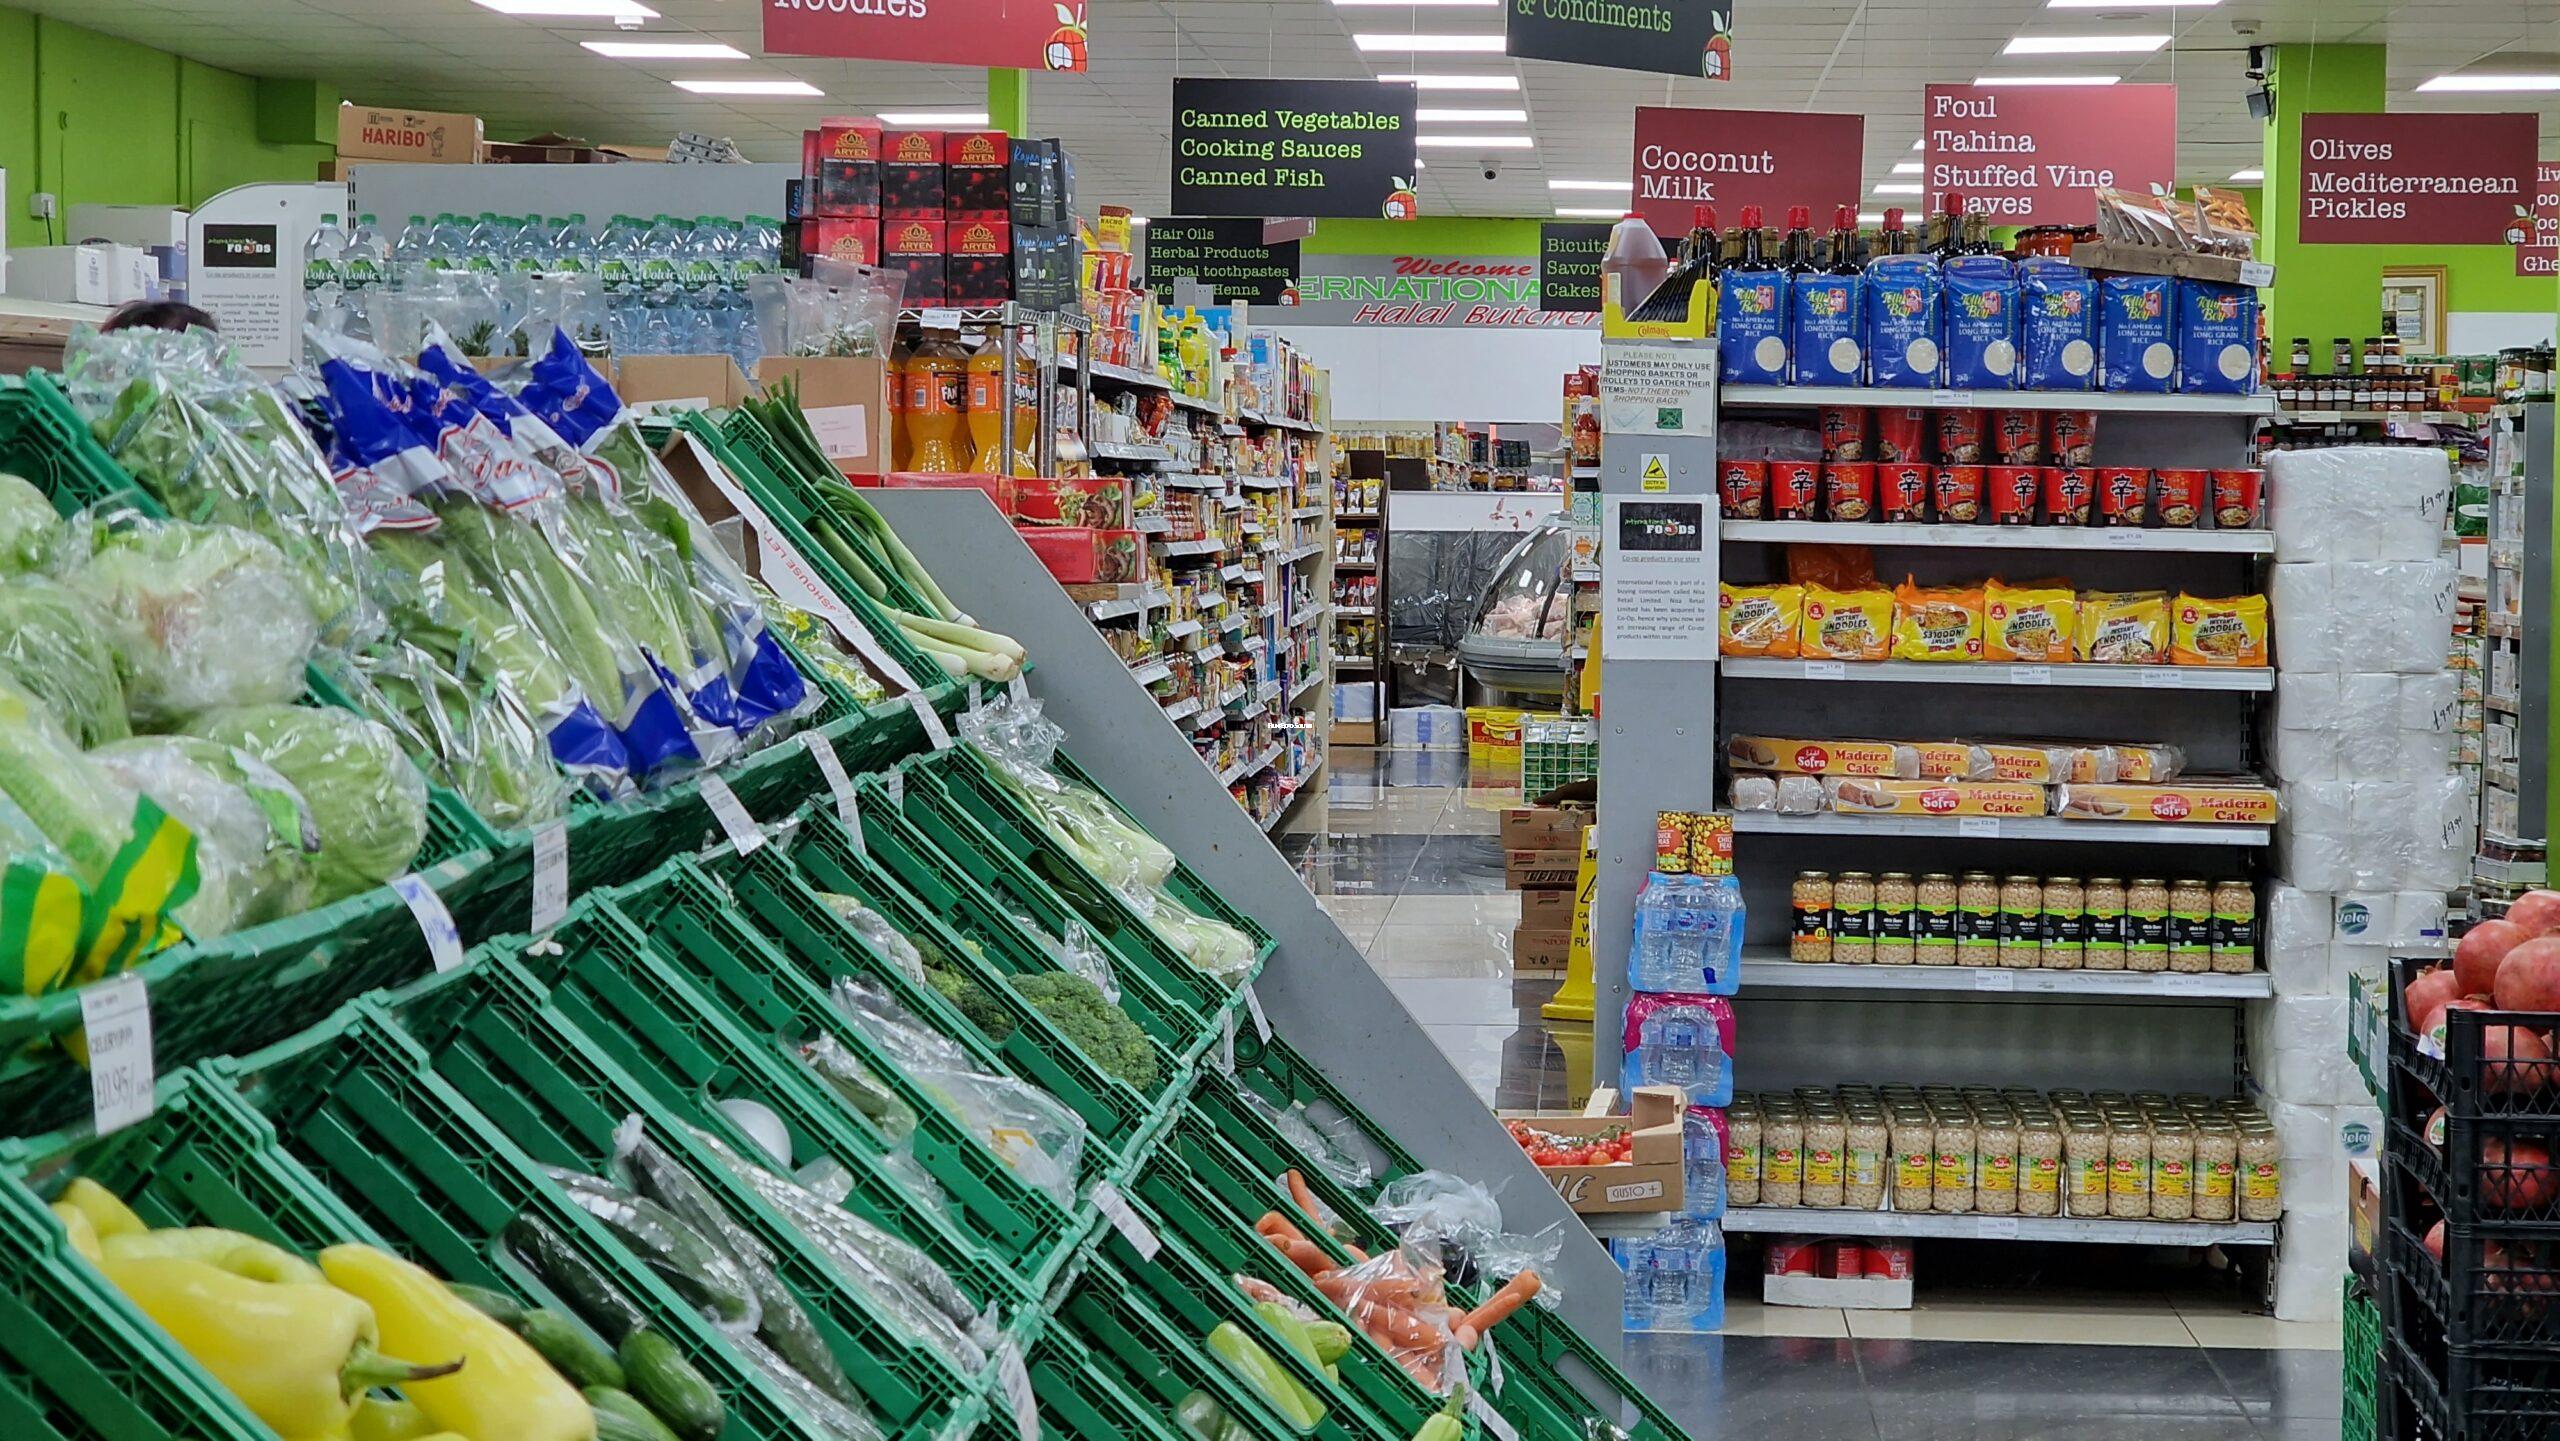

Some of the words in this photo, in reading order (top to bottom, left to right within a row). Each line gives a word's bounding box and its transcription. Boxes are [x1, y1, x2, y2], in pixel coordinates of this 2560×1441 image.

[1543, 0, 1672, 32] Condiments
[1934, 95, 1997, 119] Foul
[1181, 109, 1268, 129] Canned
[1274, 110, 1400, 132] Vegetables
[362, 127, 425, 148] HARIBO
[1933, 130, 2035, 153] Tahina
[834, 148, 869, 157] ARYEN
[1180, 138, 1275, 160] Cooking
[1281, 139, 1362, 158] Sauces
[2309, 139, 2393, 160] Olives
[898, 152, 932, 160] ARYEN
[962, 154, 996, 162] ARYEN
[1642, 145, 1774, 174] Coconut
[1180, 167, 1268, 186] Canned
[1274, 168, 1326, 187] Fish
[1933, 164, 2038, 188] Stuffed
[2046, 165, 2114, 188] Vine
[2308, 172, 2519, 193] Mediterranean
[1640, 175, 1715, 202] Milk
[1932, 192, 2033, 215] Laves
[2308, 197, 2407, 219] Pickles
[1150, 228, 1184, 240] Hair
[1187, 228, 1215, 240] Oils
[900, 242, 933, 250] ARYEN
[1546, 237, 1608, 254] Bicuits
[832, 252, 865, 262] ARYEN
[1150, 246, 1199, 259] Herbal
[1203, 247, 1269, 260] Products
[1150, 265, 1199, 278] Herbal
[1203, 266, 1290, 280] toothpastes
[1392, 255, 1532, 278] Welcome
[1546, 260, 1601, 277] Savor
[305, 267, 337, 282] Volvic
[345, 267, 378, 282] Volvic
[600, 269, 632, 282] Volvic
[641, 268, 676, 281] Volvic
[684, 270, 719, 283] Volvic
[1213, 284, 1261, 296] Henna
[1545, 283, 1600, 298] Cakes
[1353, 302, 1455, 324] Halal
[1462, 303, 1601, 326] Butcher
[1638, 326, 1670, 338] Colman's
[1654, 360, 1670, 368] MAY
[1672, 362, 1693, 370] ONLY
[1606, 368, 1647, 377] SHOPPING
[1648, 370, 1685, 378] BASKETS
[1640, 378, 1651, 386] TO
[1653, 378, 1685, 388] GATHER
[1688, 380, 1711, 388] THEIR
[1647, 388, 1670, 396] THEIR
[1672, 389, 1691, 397] OWN
[1614, 395, 1655, 404] SHOPPING
[1656, 396, 1679, 405] BAGS
[1790, 467, 1815, 503] 辛
[1898, 470, 1922, 505] 辛
[2062, 473, 2085, 509] 辛
[2112, 474, 2136, 509] 辛
[1828, 620, 1868, 630] NOODLES
[2012, 618, 2051, 630] NOODLES
[2203, 623, 2243, 633] NOODLES
[1834, 750, 1889, 762] Madeira
[1798, 757, 1826, 769] Sofra
[1846, 763, 1880, 774] Cake
[1999, 768, 2033, 780] Cake
[1969, 789, 2035, 802] Madeira
[1922, 797, 1956, 809] Sofra
[1982, 803, 2024, 814] Cake
[2200, 798, 2267, 810] Madeira
[2153, 804, 2188, 817] Sofra
[2214, 811, 2257, 822] Cake
[1612, 1186, 1645, 1199] GUSTO
